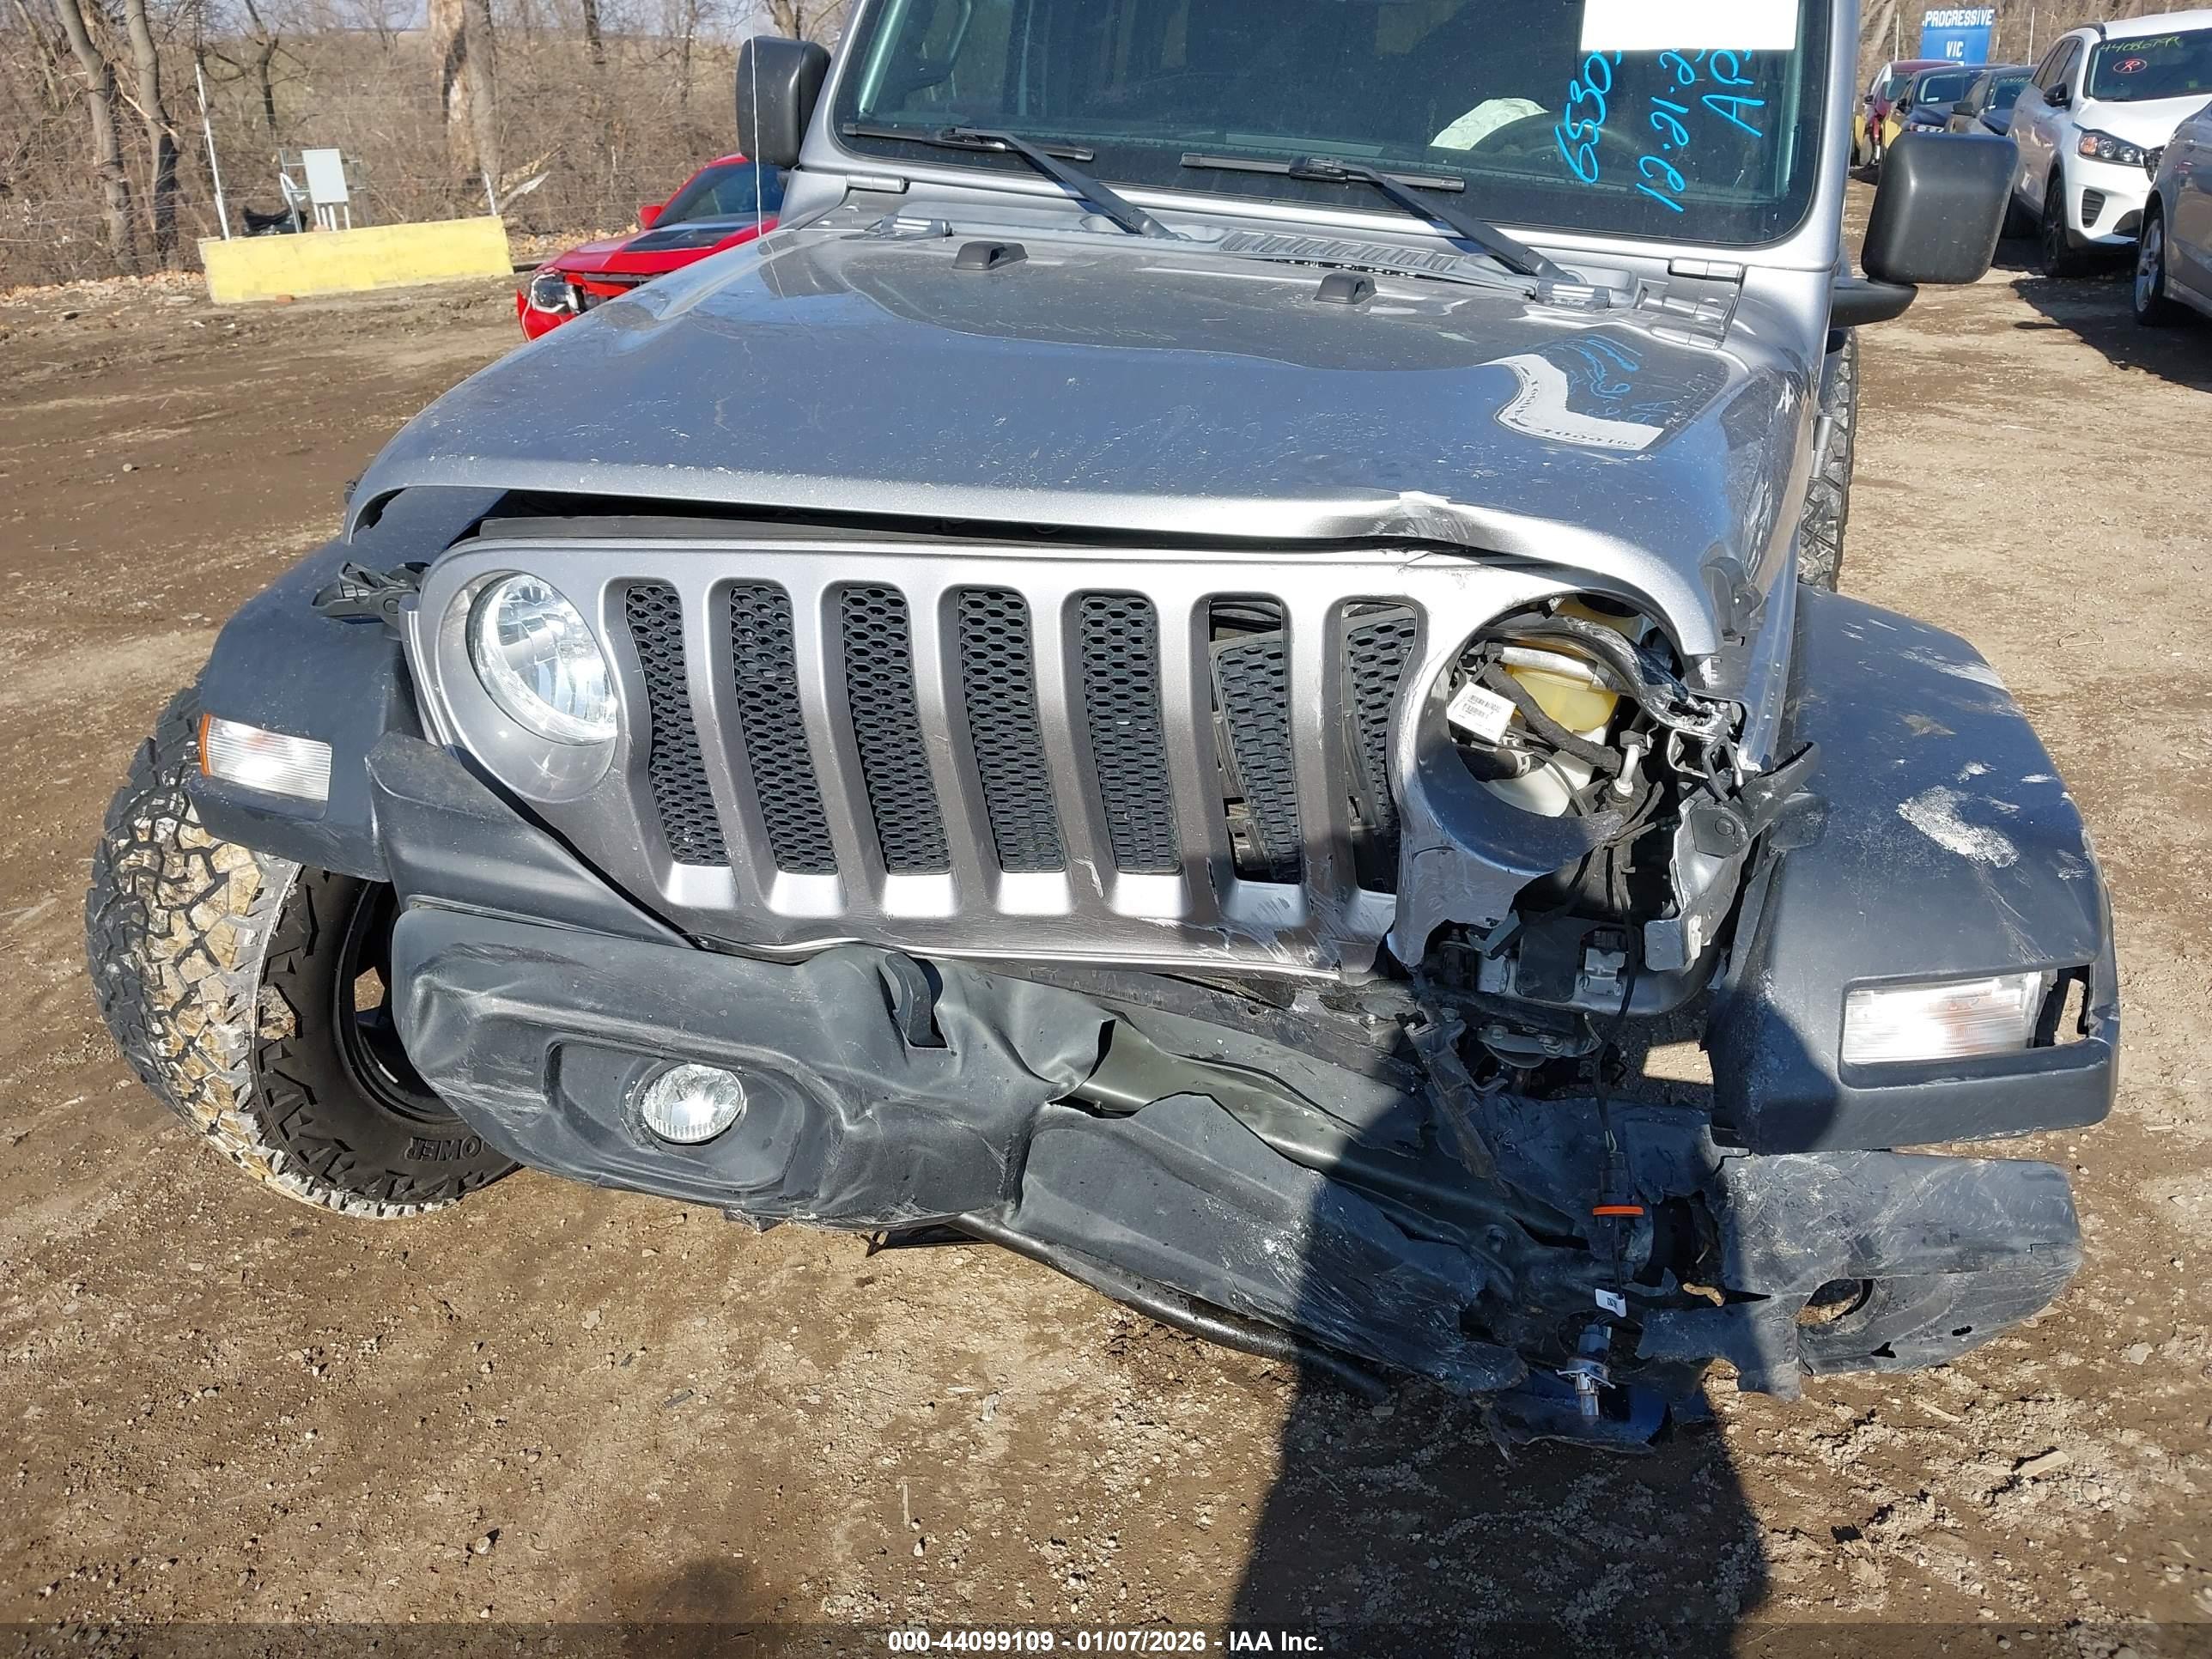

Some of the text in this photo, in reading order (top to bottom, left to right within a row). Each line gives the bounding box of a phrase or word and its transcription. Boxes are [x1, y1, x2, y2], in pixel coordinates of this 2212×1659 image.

[1924, 9, 1995, 27] PROGRESSIVE
[1946, 40, 1964, 58] VIC
[1554, 49, 1622, 184] 6530
[404, 1135, 492, 1161] OWER
